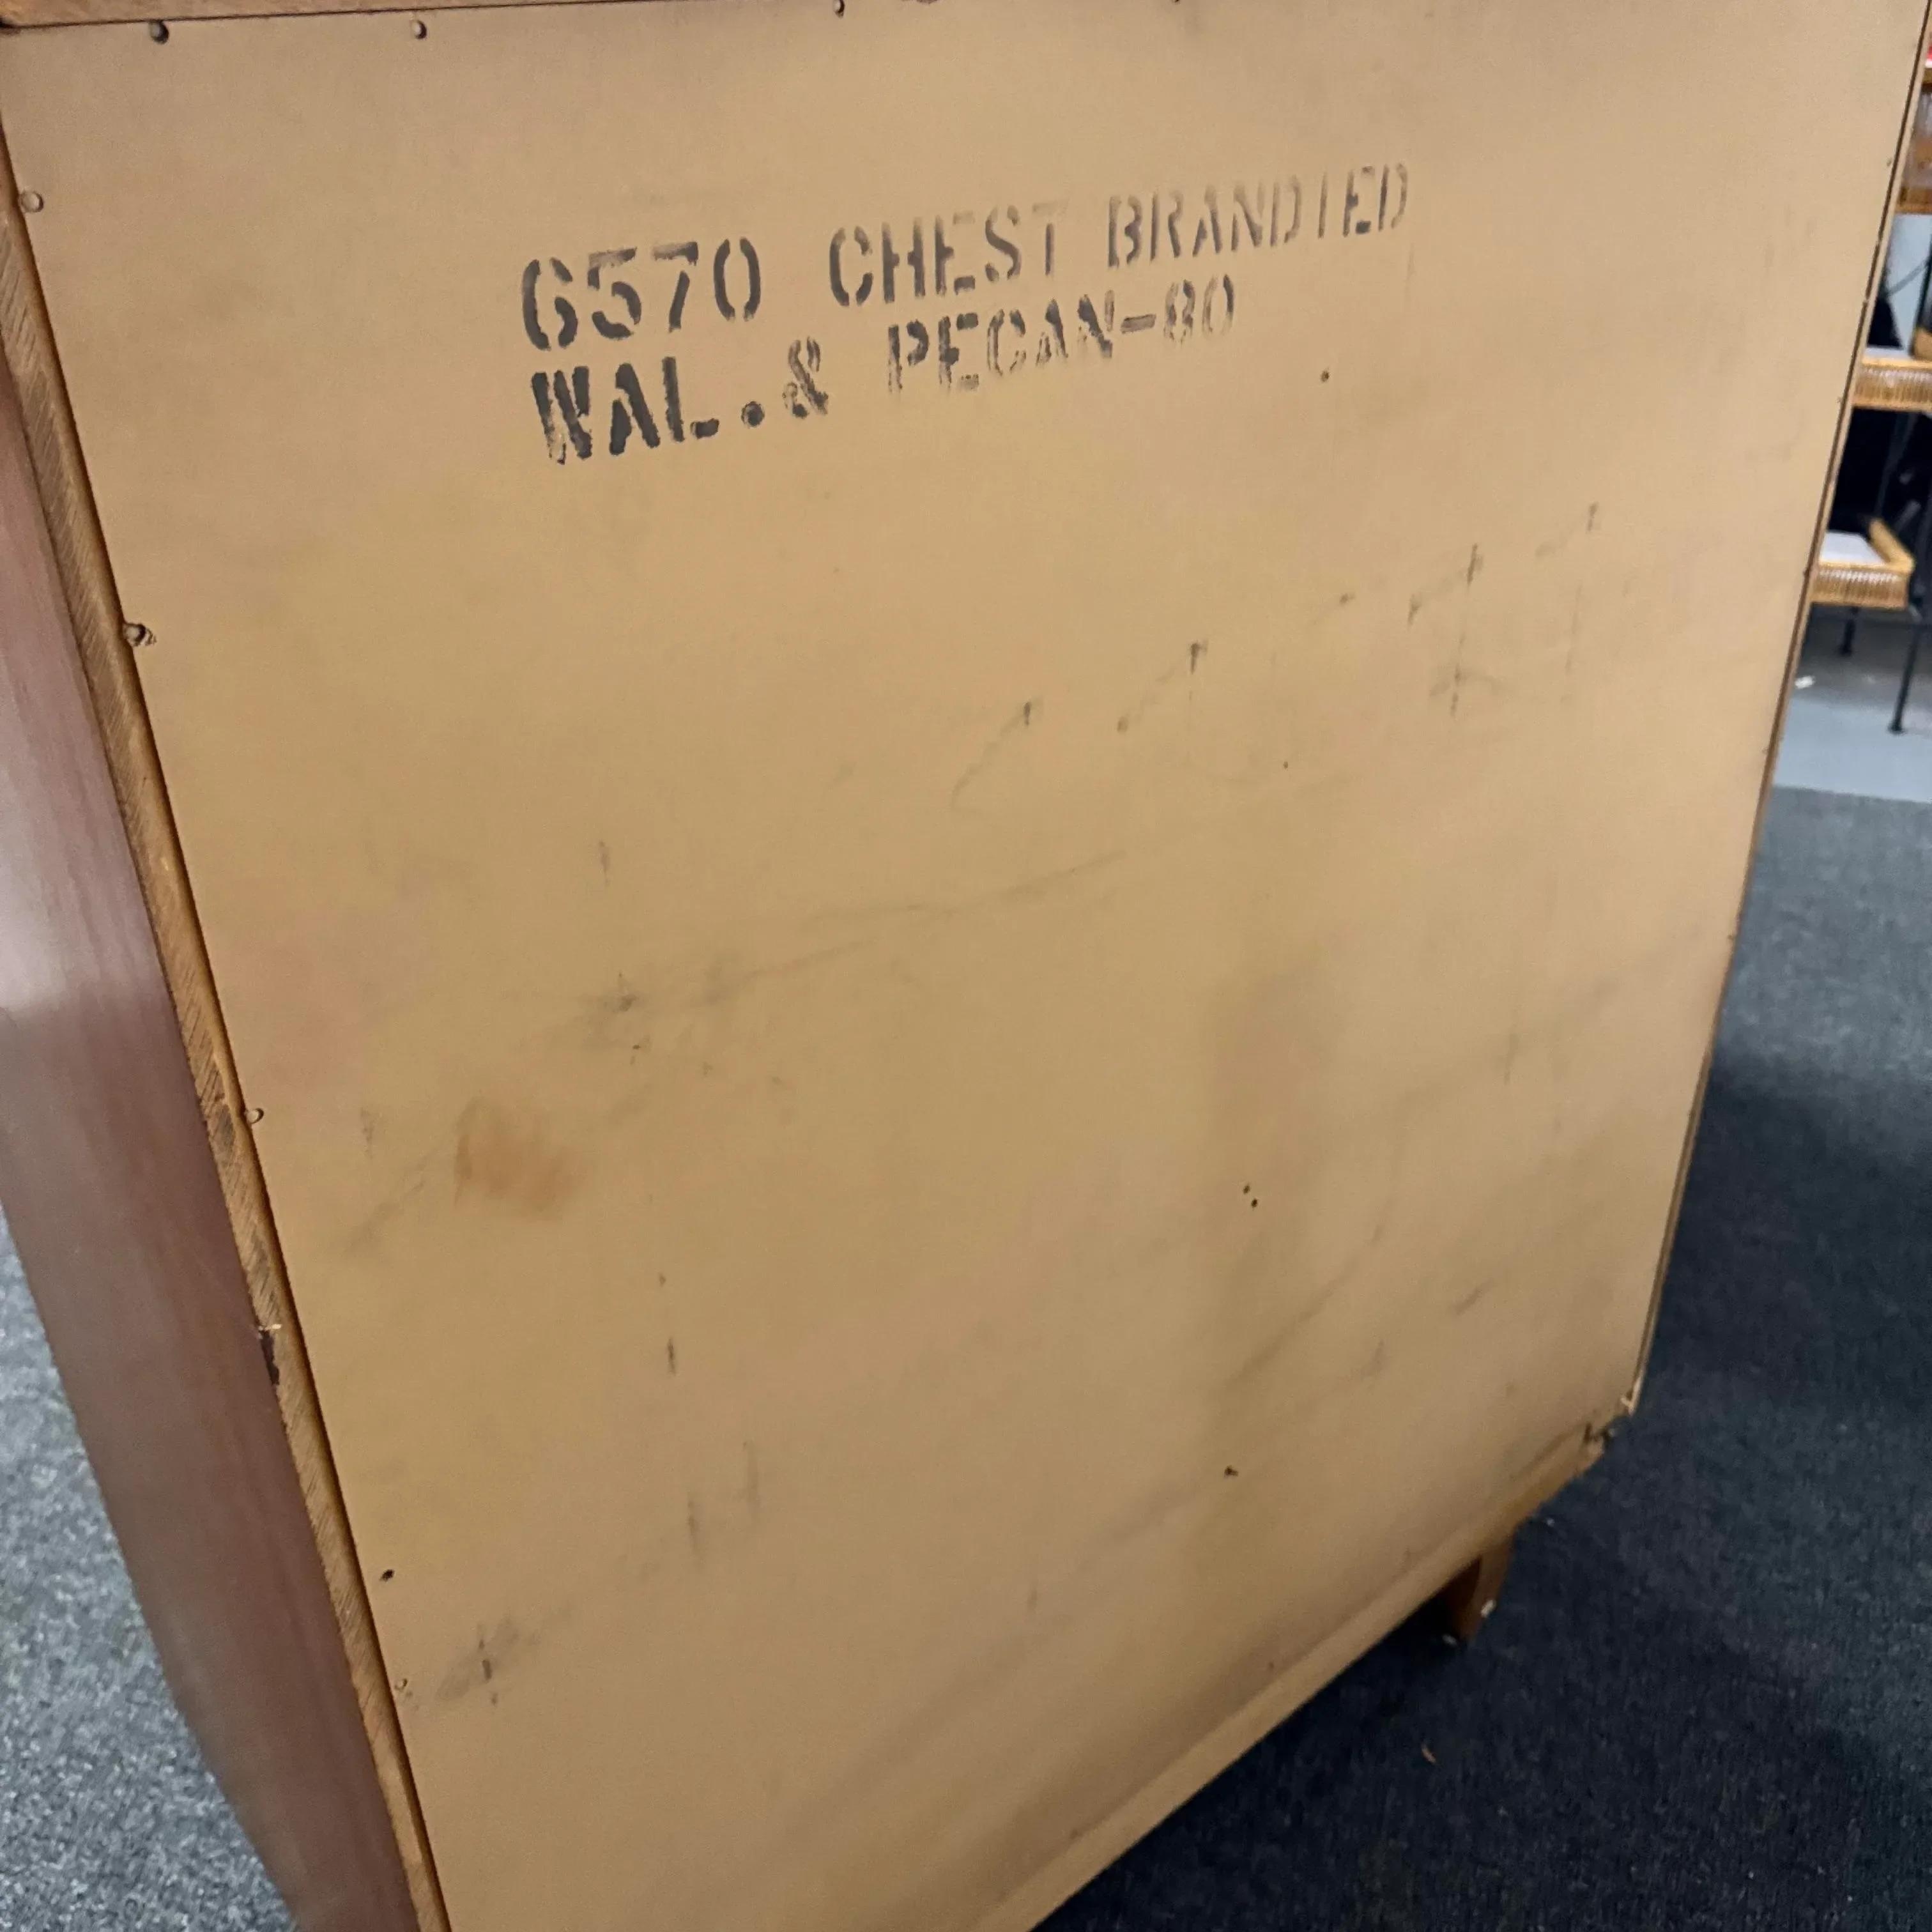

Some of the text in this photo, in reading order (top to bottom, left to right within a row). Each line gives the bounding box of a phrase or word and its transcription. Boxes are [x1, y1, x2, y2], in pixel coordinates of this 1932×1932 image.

[521, 162, 1407, 351] 6570 CHEST BRANDIED
